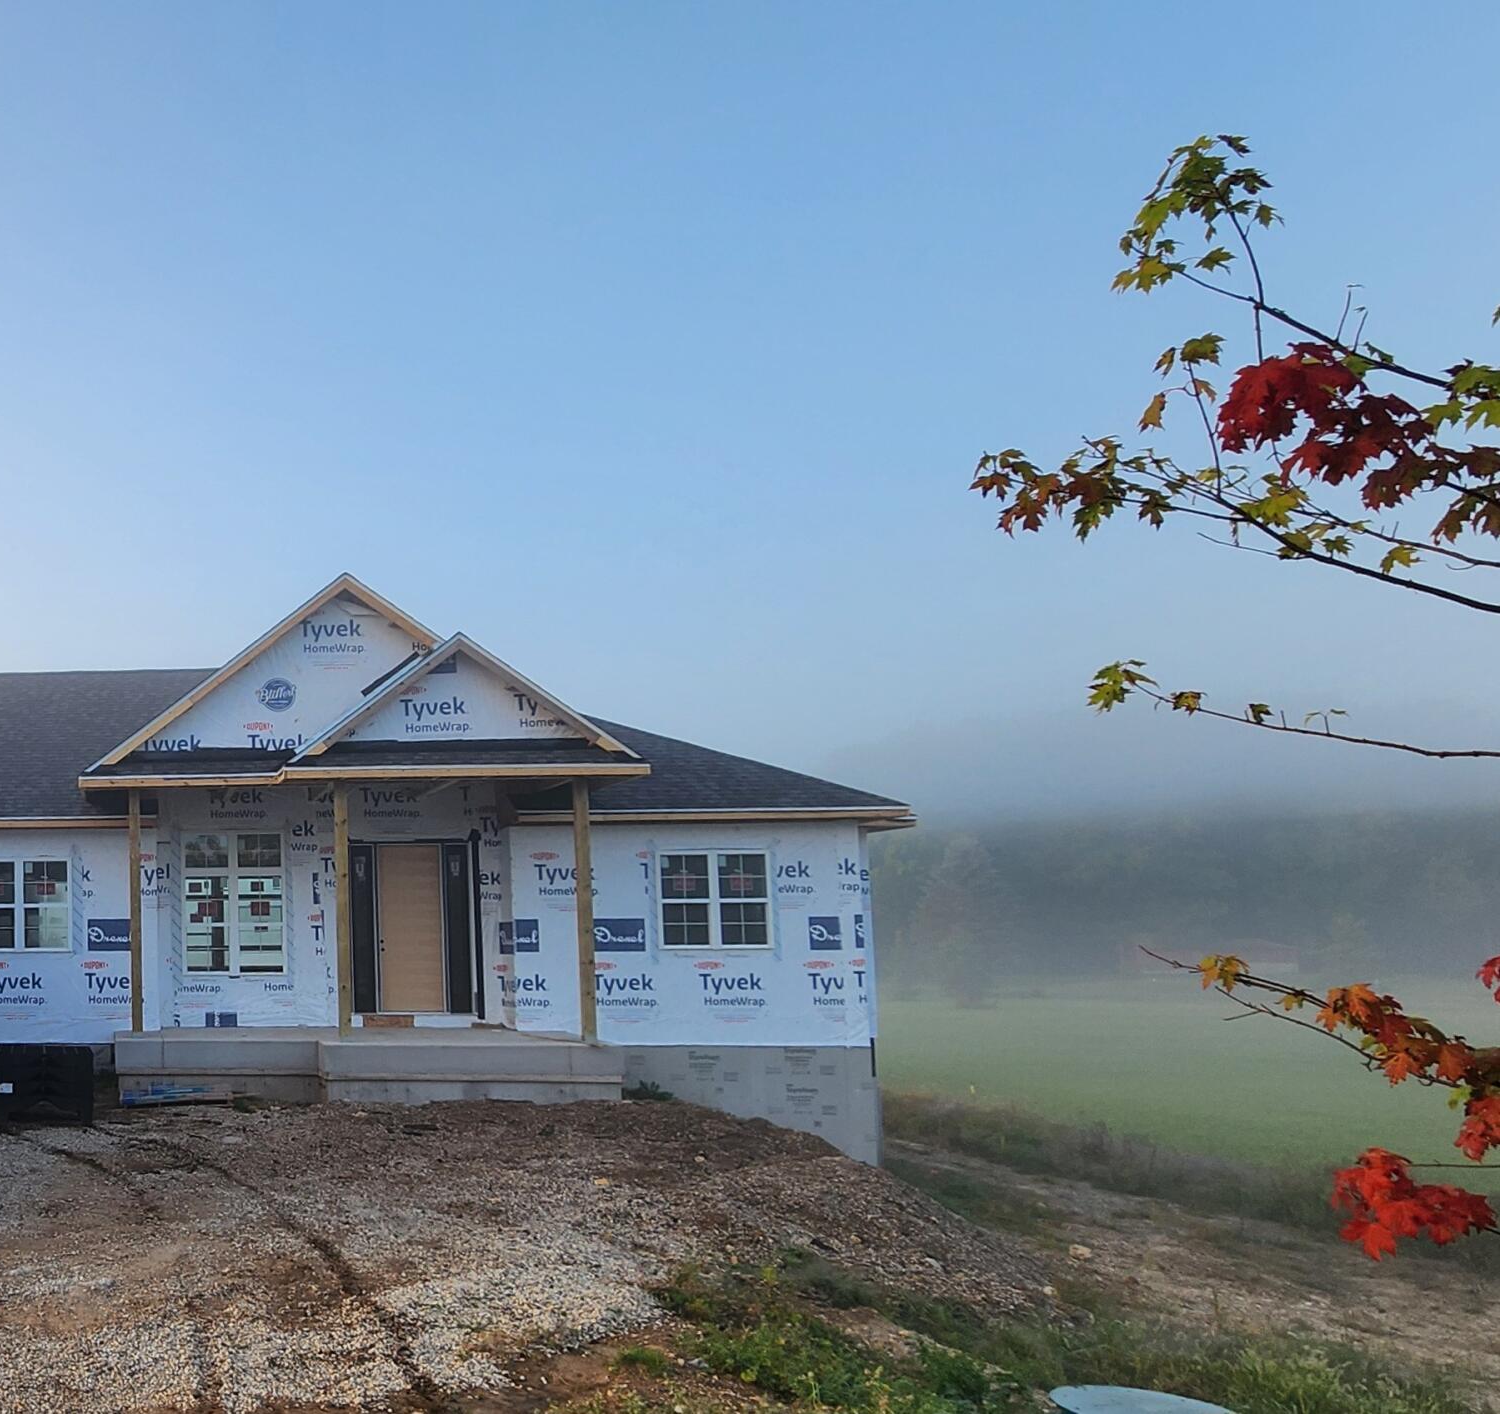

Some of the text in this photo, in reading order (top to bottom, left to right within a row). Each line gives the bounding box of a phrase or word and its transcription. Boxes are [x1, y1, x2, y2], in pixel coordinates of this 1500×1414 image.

[300, 619, 362, 643] Tyvek
[303, 643, 364, 655] HomeWrap
[399, 696, 466, 722] Tyvek
[405, 721, 470, 735] HomeWrap
[519, 717, 556, 729] Home
[359, 785, 418, 806] Tyvek
[364, 808, 420, 820] HomeWrap
[291, 842, 318, 853] Wrap
[480, 890, 502, 901] Wrap
[539, 886, 598, 897] Homep
[778, 884, 814, 895] eWrap
[809, 924, 841, 942] Dre
[84, 972, 130, 994] Tyve
[178, 983, 221, 994] meWrap
[264, 982, 295, 993] Home
[594, 973, 654, 995] Tyvek
[699, 973, 762, 995] Tyvek
[808, 973, 844, 995] Tyv
[88, 994, 134, 1006] HomeWr
[501, 998, 550, 1008] eWrap
[596, 997, 657, 1008] HomeWrap
[704, 996, 766, 1007] HomeWrap
[813, 997, 845, 1007] Home
